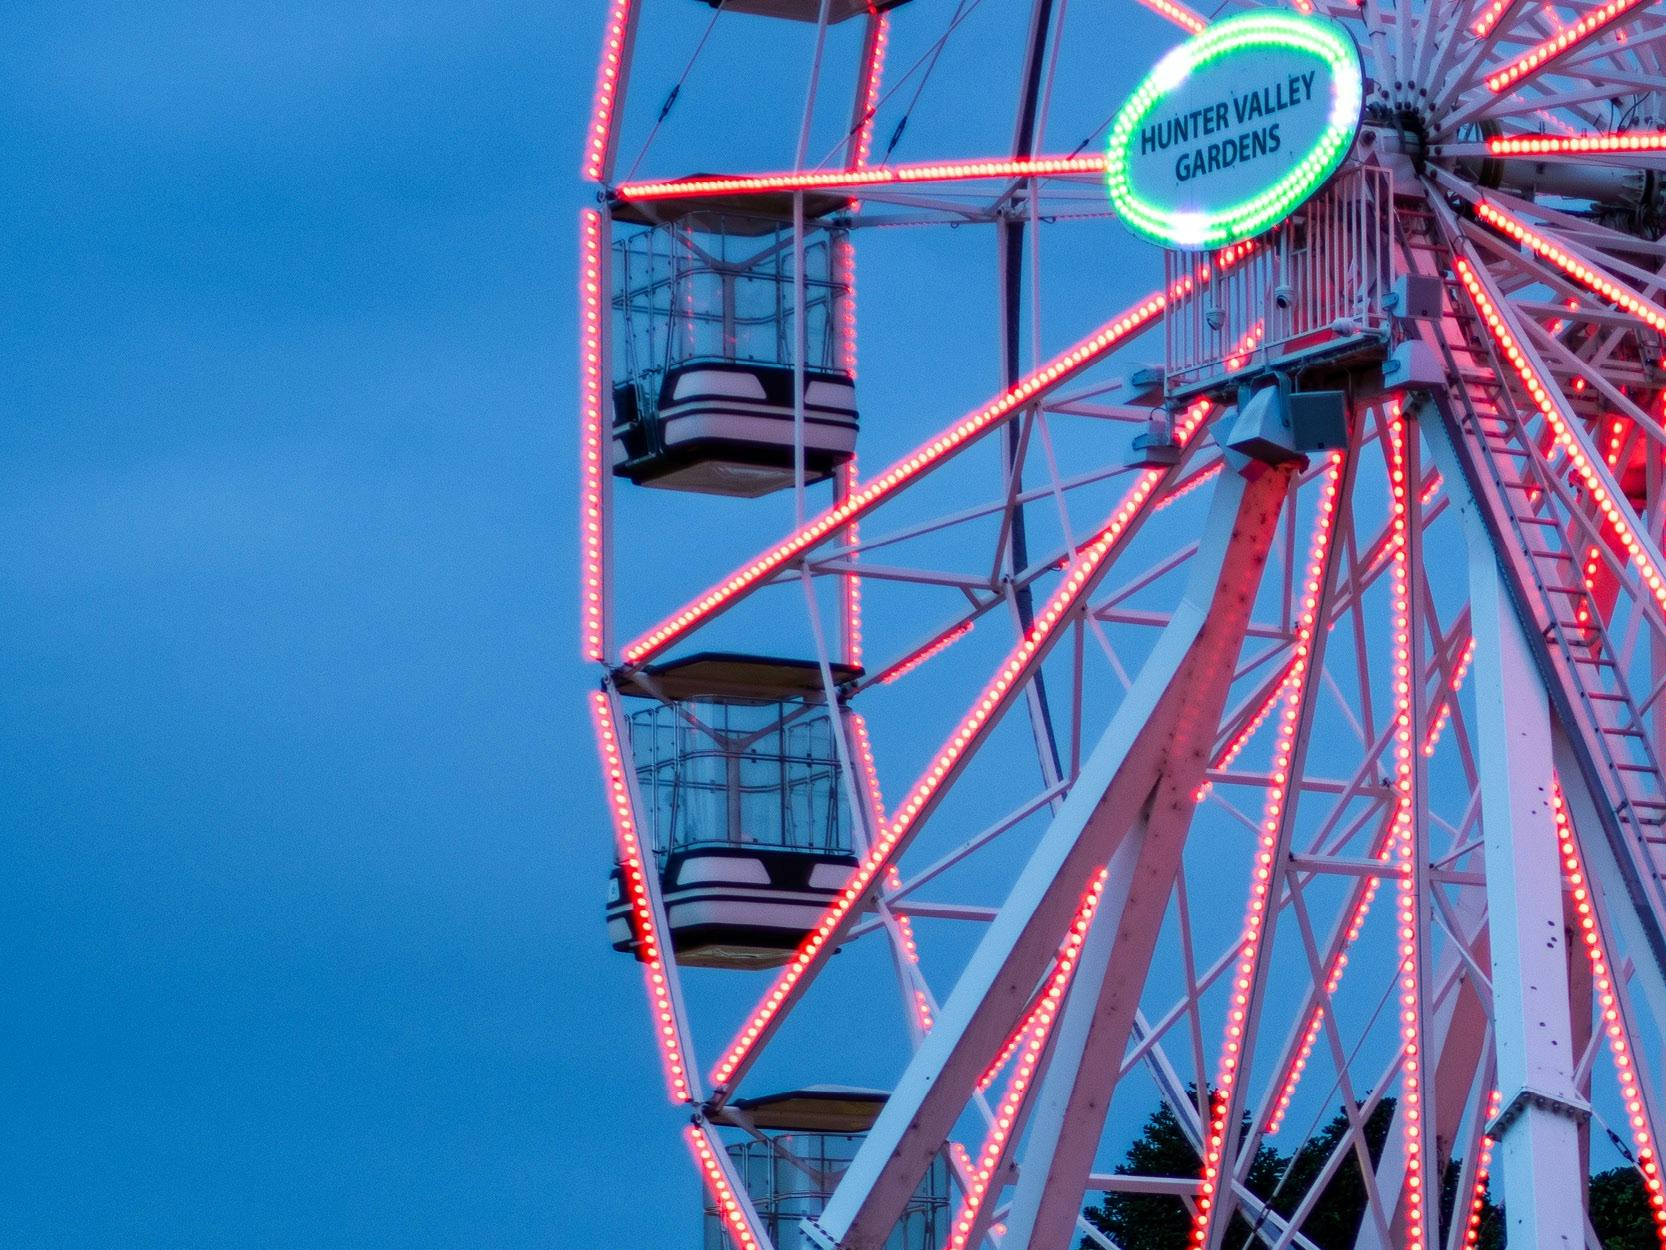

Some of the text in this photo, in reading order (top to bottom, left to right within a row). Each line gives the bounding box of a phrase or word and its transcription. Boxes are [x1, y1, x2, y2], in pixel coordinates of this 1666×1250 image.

[1141, 71, 1315, 155] HUNTER VALLEY
[1175, 123, 1281, 182] GARDENS
